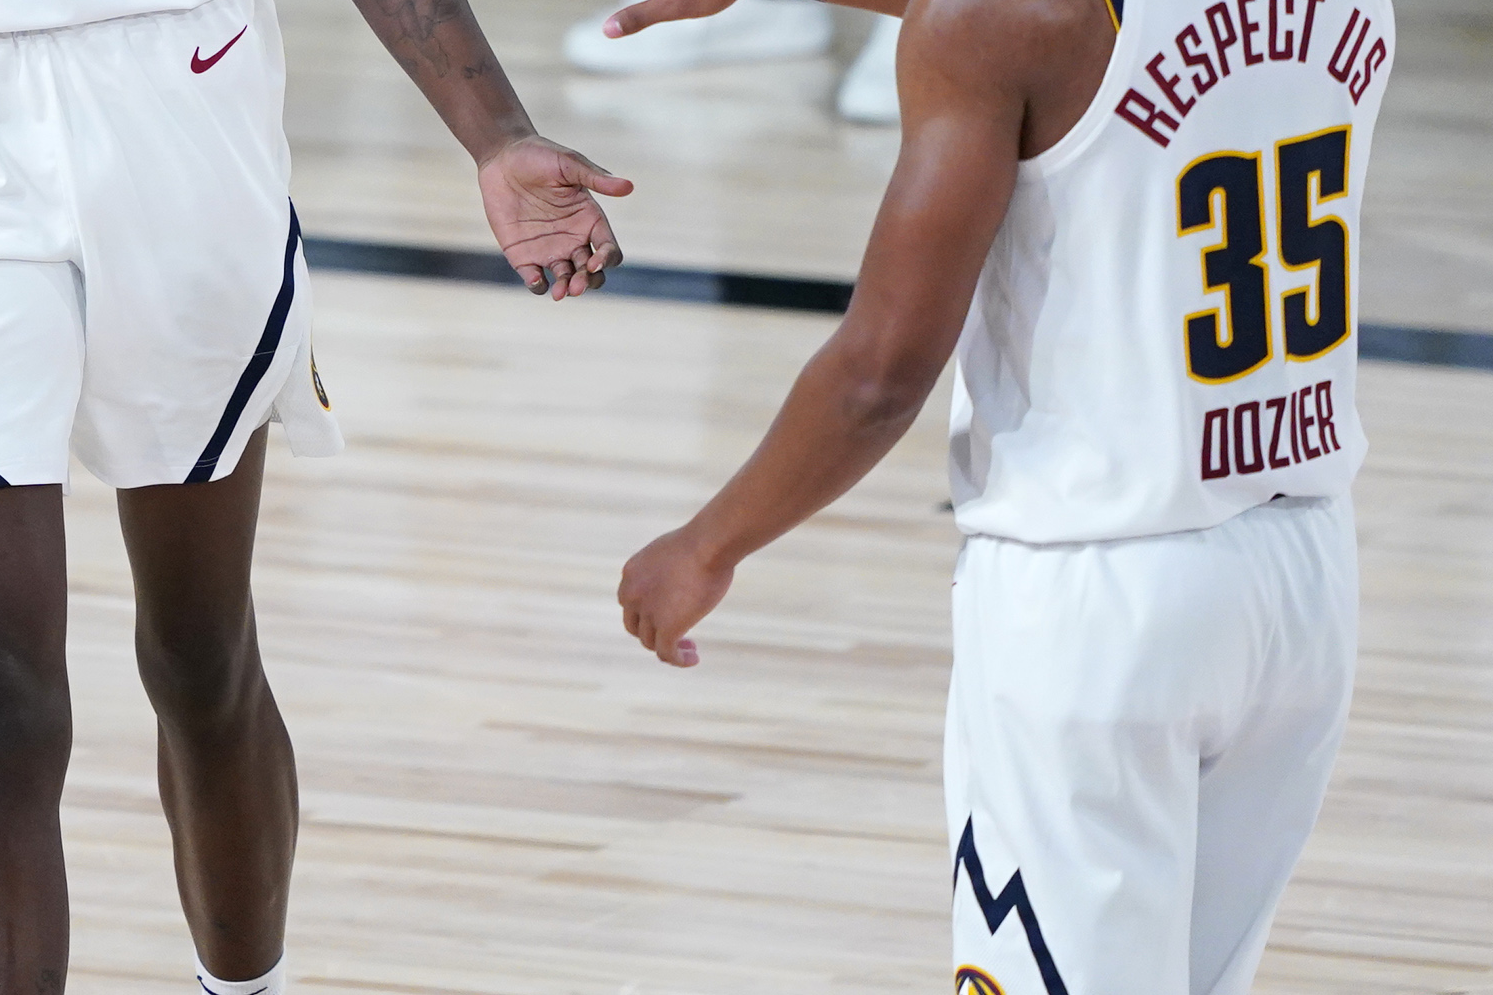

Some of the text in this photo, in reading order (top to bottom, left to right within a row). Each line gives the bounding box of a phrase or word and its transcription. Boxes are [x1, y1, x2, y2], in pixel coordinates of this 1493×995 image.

[1328, 8, 1387, 106] US
[1177, 124, 1353, 385] 35
[1201, 380, 1342, 482] DOZIER
